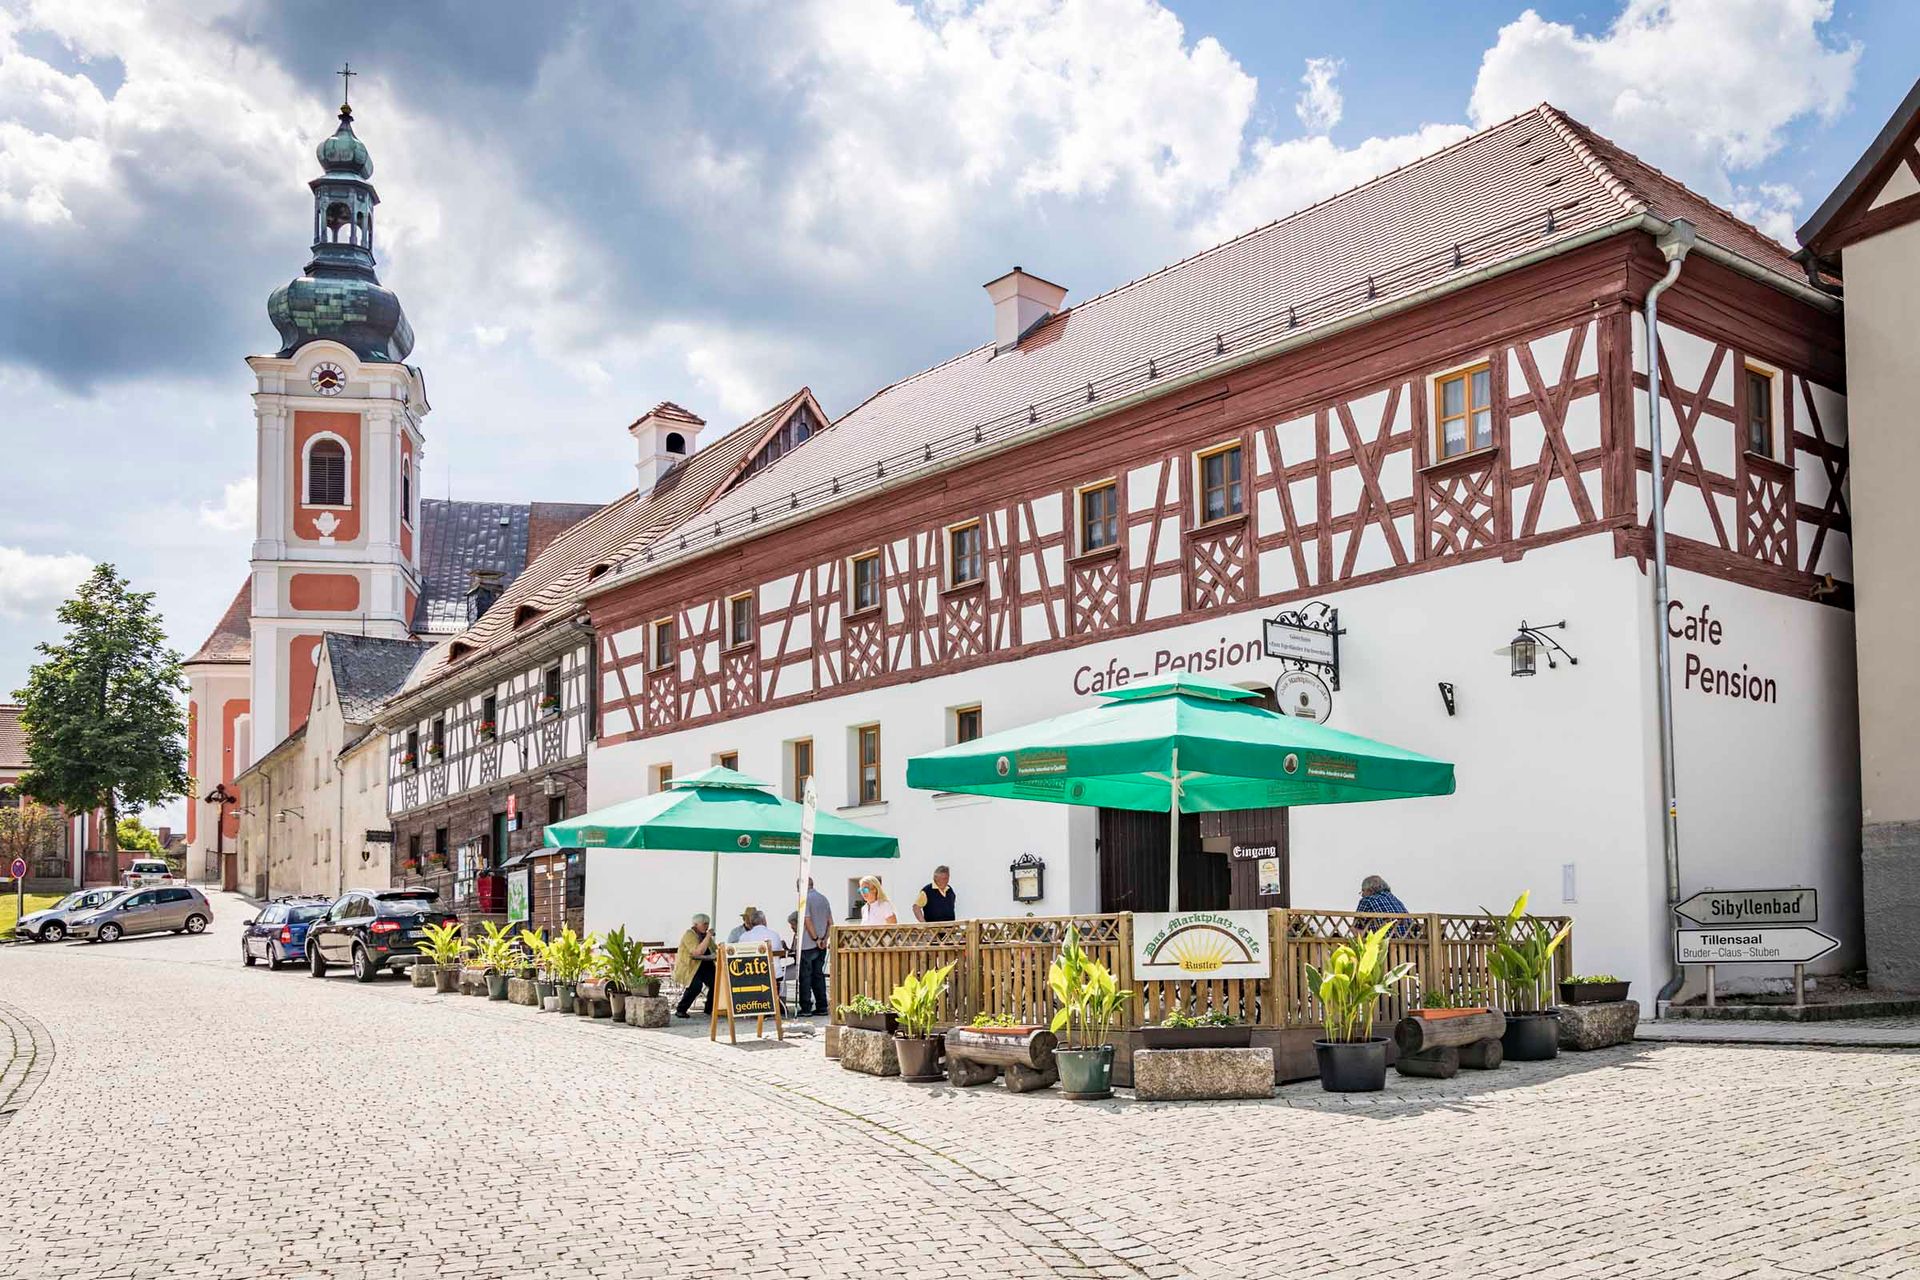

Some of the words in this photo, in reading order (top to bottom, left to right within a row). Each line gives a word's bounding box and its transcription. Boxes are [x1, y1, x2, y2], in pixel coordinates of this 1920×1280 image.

[1667, 600, 1722, 645] Cafe
[1685, 653, 1776, 703] Pension
[1232, 846, 1276, 858] Eingang
[1711, 897, 1801, 919] Sibyllenbad
[1143, 929, 1166, 957] Das
[1700, 934, 1762, 945] Tillensaal
[729, 958, 768, 976] Cafe
[735, 1000, 771, 1012] geöffnet
